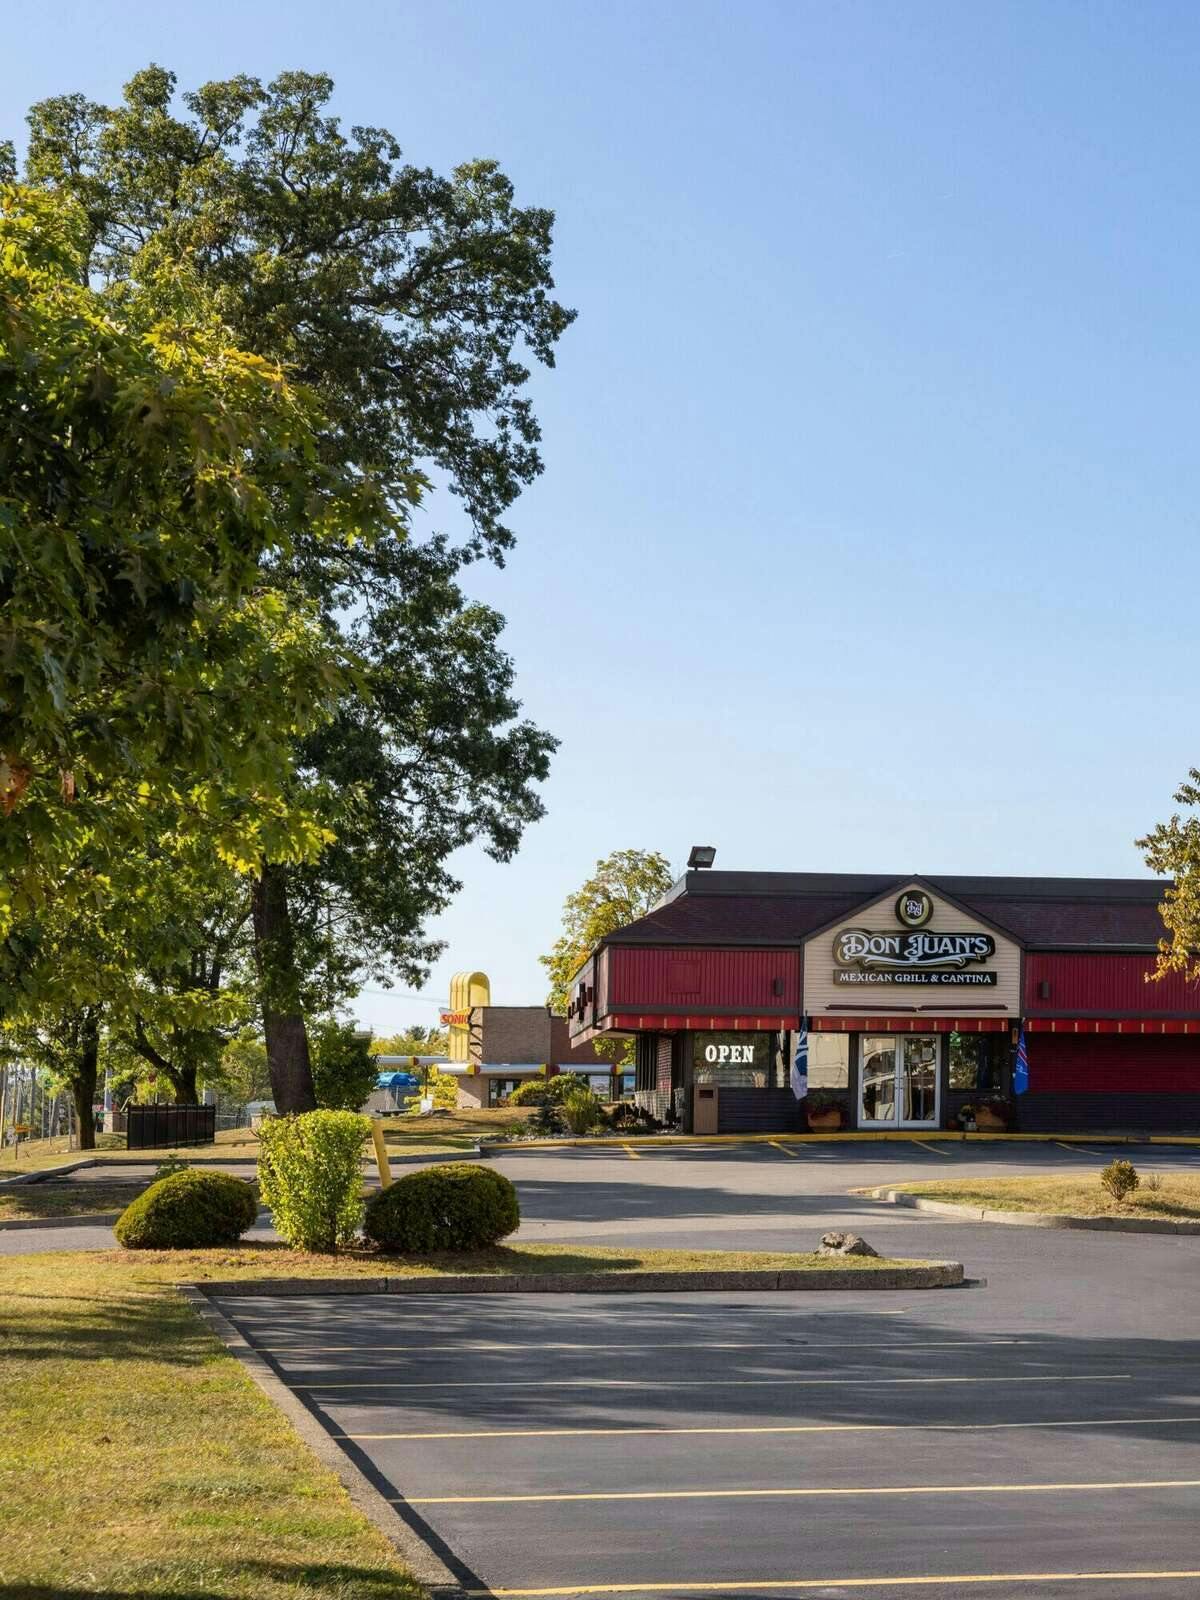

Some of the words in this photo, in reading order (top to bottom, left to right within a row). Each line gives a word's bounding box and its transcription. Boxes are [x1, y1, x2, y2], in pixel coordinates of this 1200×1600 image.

[839, 973, 892, 983] MEXICAN
[894, 973, 928, 984] GRILL
[930, 974, 939, 984] &
[941, 974, 992, 984] CANTINA
[705, 1044, 755, 1063] OPEN
